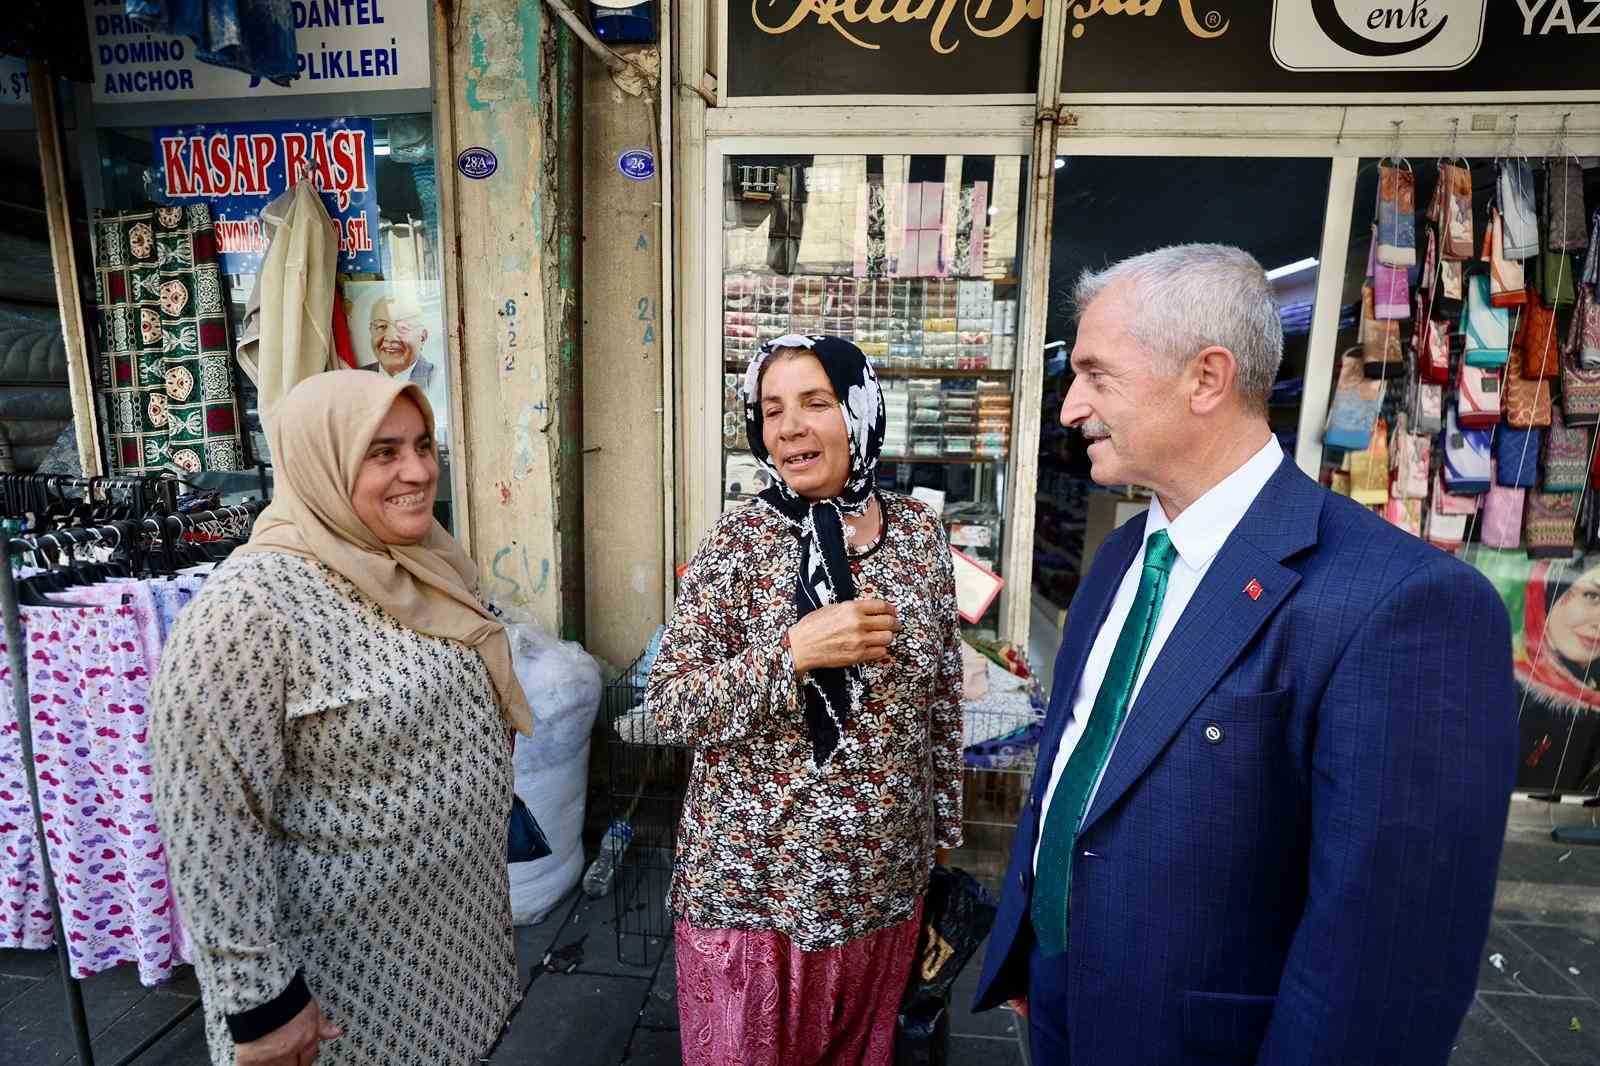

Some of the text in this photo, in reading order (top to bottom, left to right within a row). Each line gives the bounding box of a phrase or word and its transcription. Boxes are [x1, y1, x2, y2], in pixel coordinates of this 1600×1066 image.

[294, 0, 385, 28] DANTEL
[99, 35, 185, 65] DOMİNO
[104, 69, 194, 94] ANCHOR
[161, 133, 276, 196] KASAP
[631, 157, 645, 170] 26
